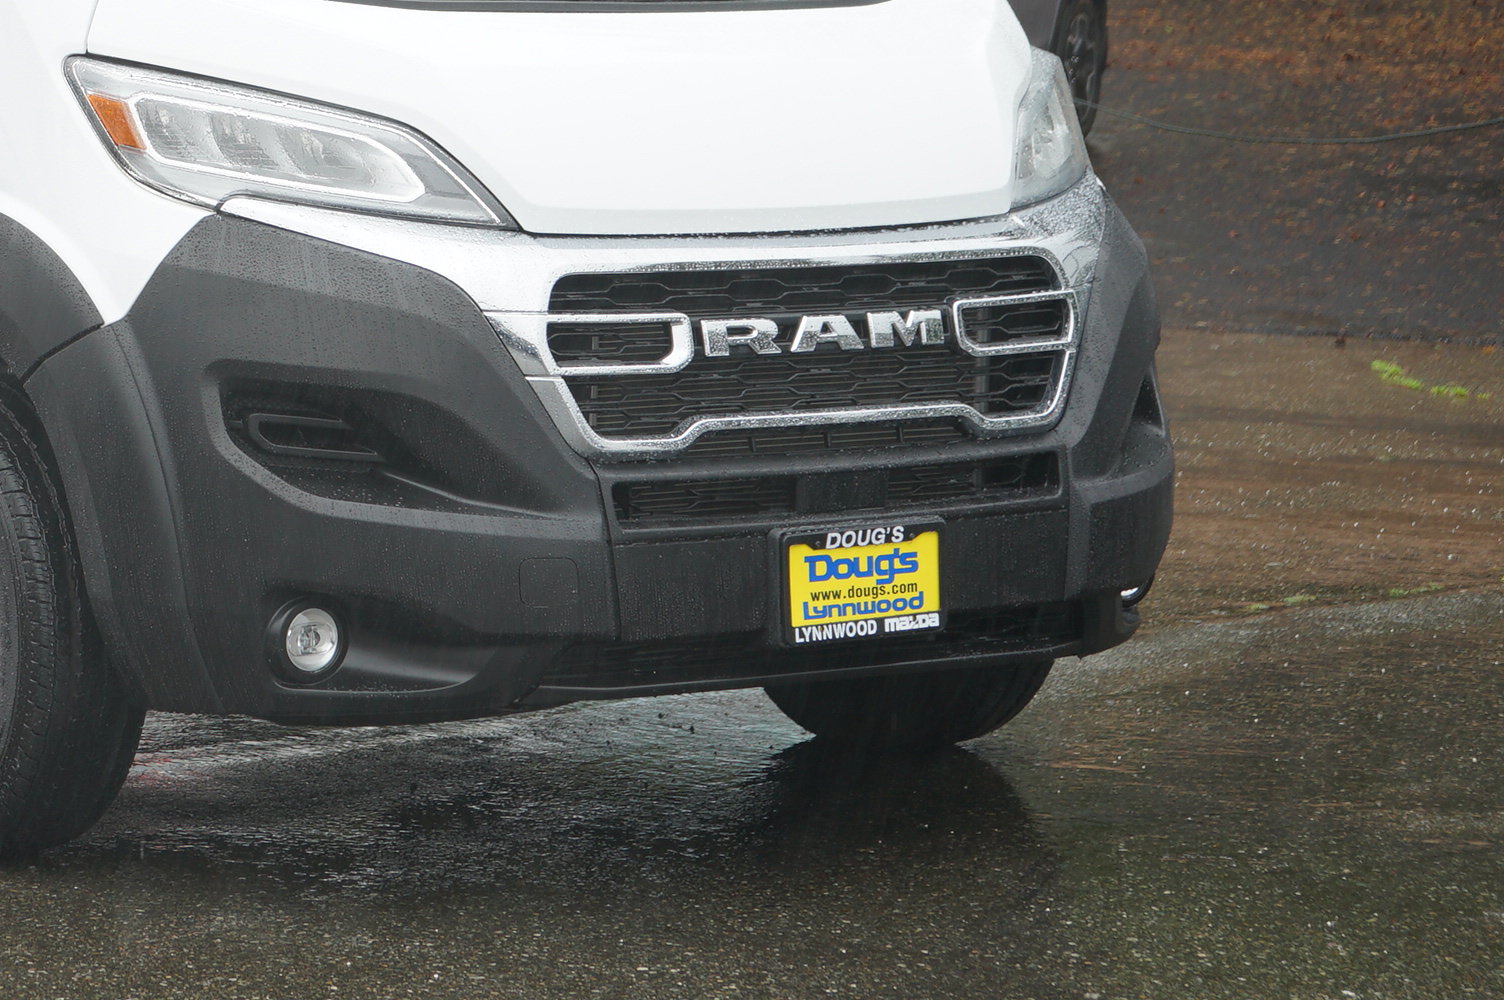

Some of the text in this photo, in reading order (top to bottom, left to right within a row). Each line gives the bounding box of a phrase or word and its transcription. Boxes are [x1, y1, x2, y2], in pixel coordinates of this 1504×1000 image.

[700, 309, 944, 357] RAM
[826, 526, 905, 550] DOUG'S
[804, 548, 919, 585] Doug's
[810, 582, 918, 602] www.dougs.com
[803, 591, 924, 621] Lynnwood
[795, 619, 878, 644] LYNNWOOD
